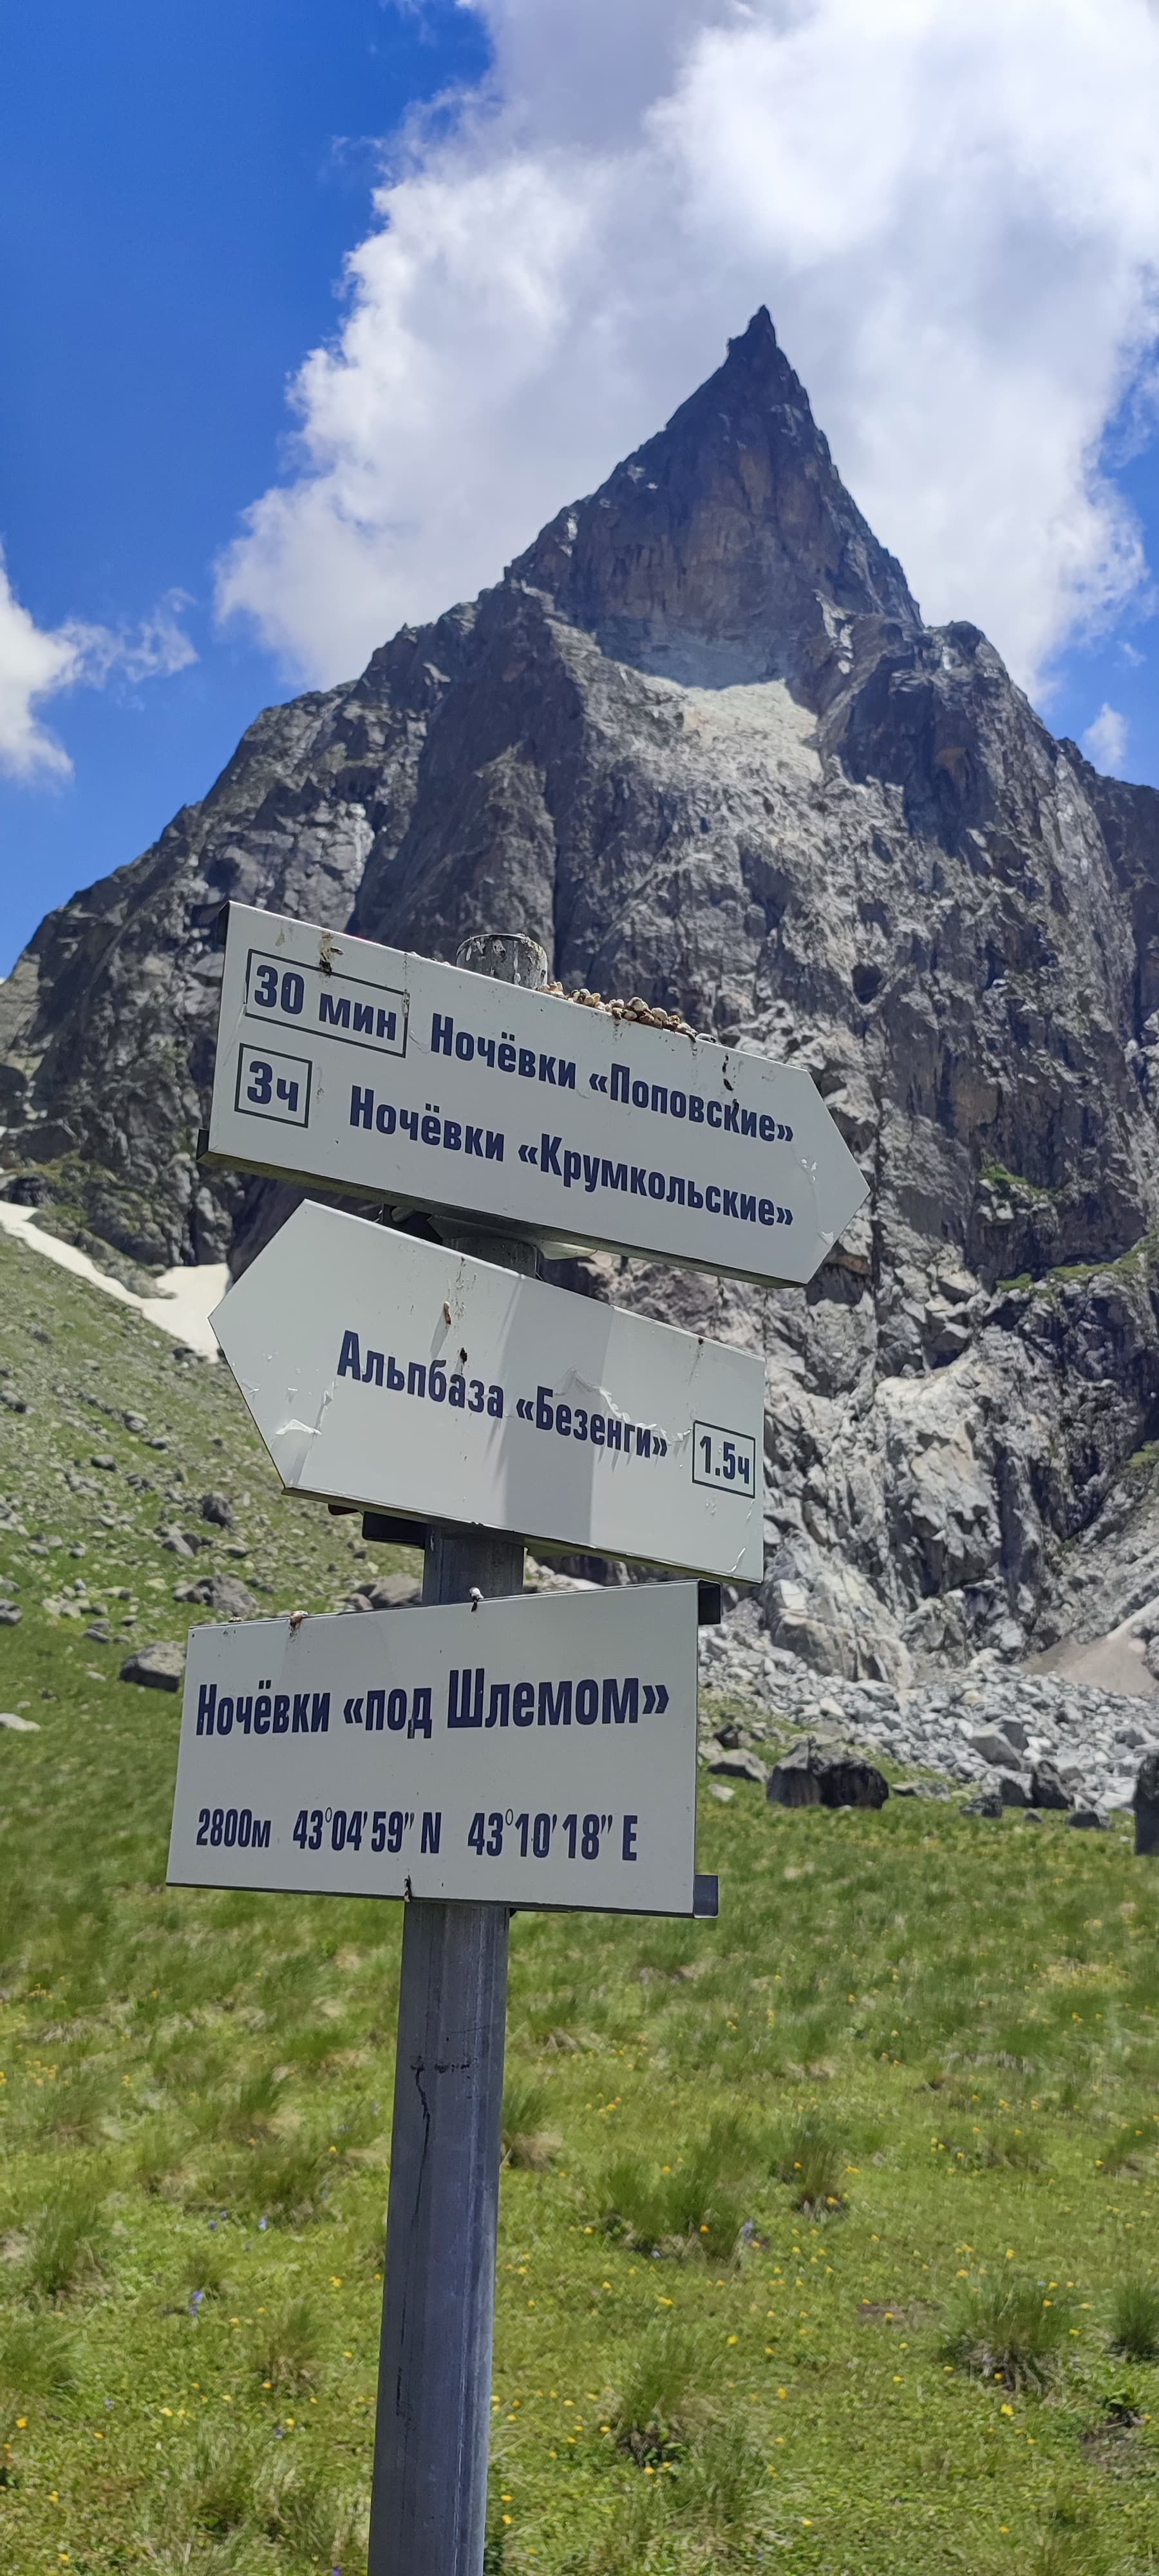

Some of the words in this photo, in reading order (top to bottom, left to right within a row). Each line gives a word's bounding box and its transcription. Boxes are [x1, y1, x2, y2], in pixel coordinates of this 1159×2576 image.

[254, 965, 305, 1015] 30
[319, 992, 397, 1041] мин
[247, 1061, 299, 1112] 3ч
[431, 1013, 576, 1090] Ночёвки
[588, 1061, 793, 1142] «Поповские»
[350, 1085, 504, 1162] Ночёвки
[518, 1133, 794, 1226] «Крумкольские»
[337, 1330, 504, 1419] Альпбаза
[516, 1386, 667, 1459] «Безенги»
[699, 1435, 749, 1484] 1.5ч
[196, 1680, 331, 1736] Ночёвки
[343, 1685, 432, 1739] «под
[447, 1668, 670, 1728] Шлемом»
[196, 1808, 272, 1848] 2800м
[420, 1812, 442, 1854] N
[622, 1815, 638, 1861] E
